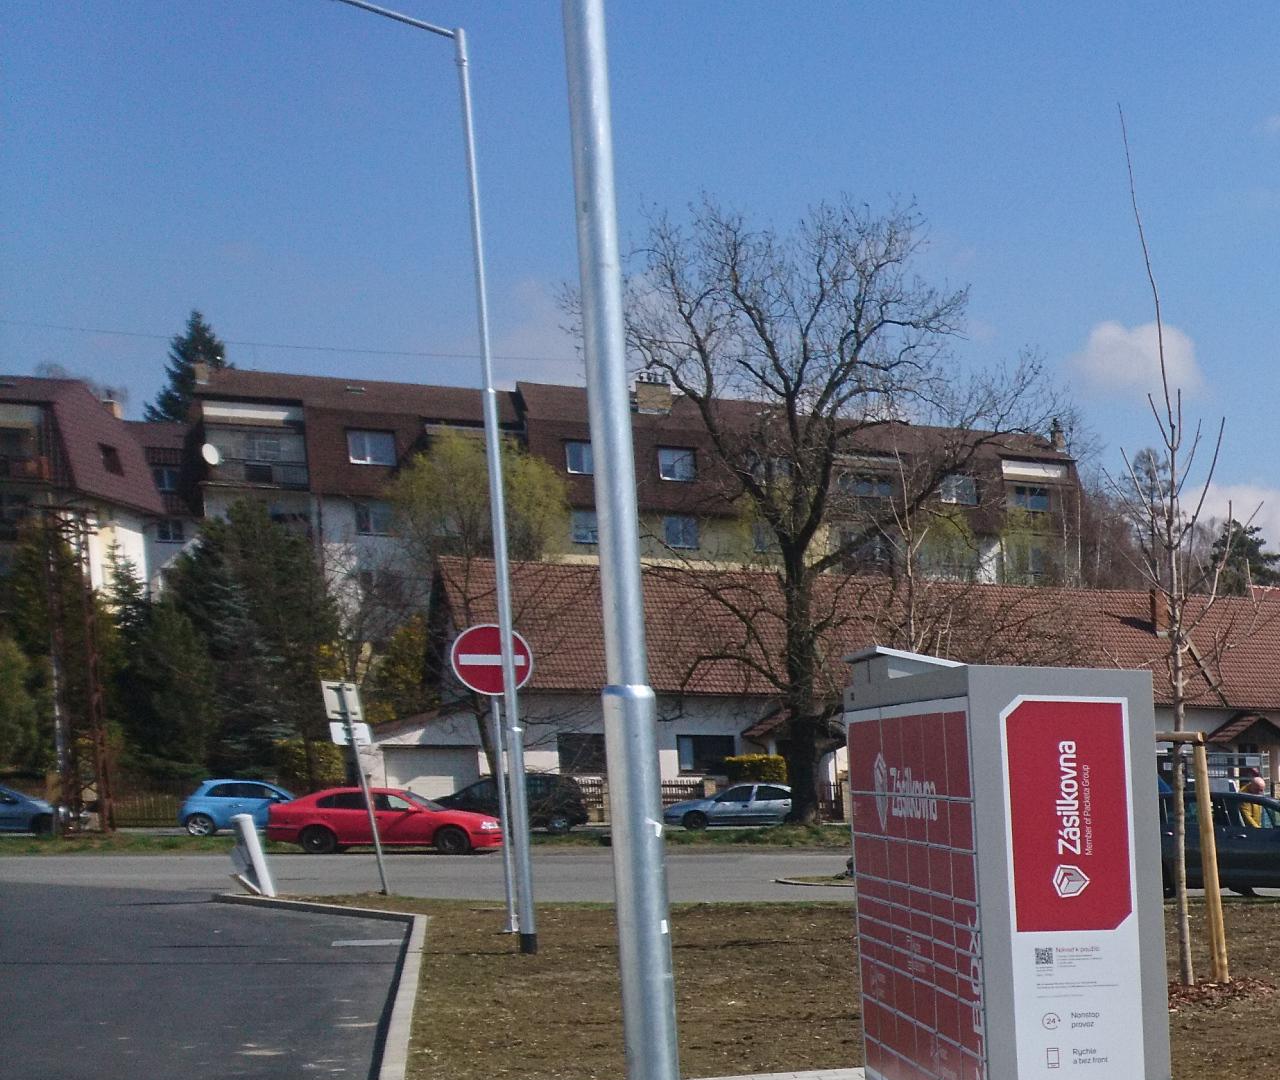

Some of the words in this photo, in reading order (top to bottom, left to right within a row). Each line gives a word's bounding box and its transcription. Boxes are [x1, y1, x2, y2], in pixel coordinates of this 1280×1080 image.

[1081, 765, 1091, 787] Group
[890, 767, 938, 821] Zásilkovna
[1056, 741, 1081, 855] Zásilkovna
[1083, 817, 1092, 826] of
[1084, 827, 1093, 856] Member
[1046, 1017, 1056, 1025] 24
[1071, 1011, 1100, 1019] Nonstop
[1071, 1021, 1095, 1029] provoz
